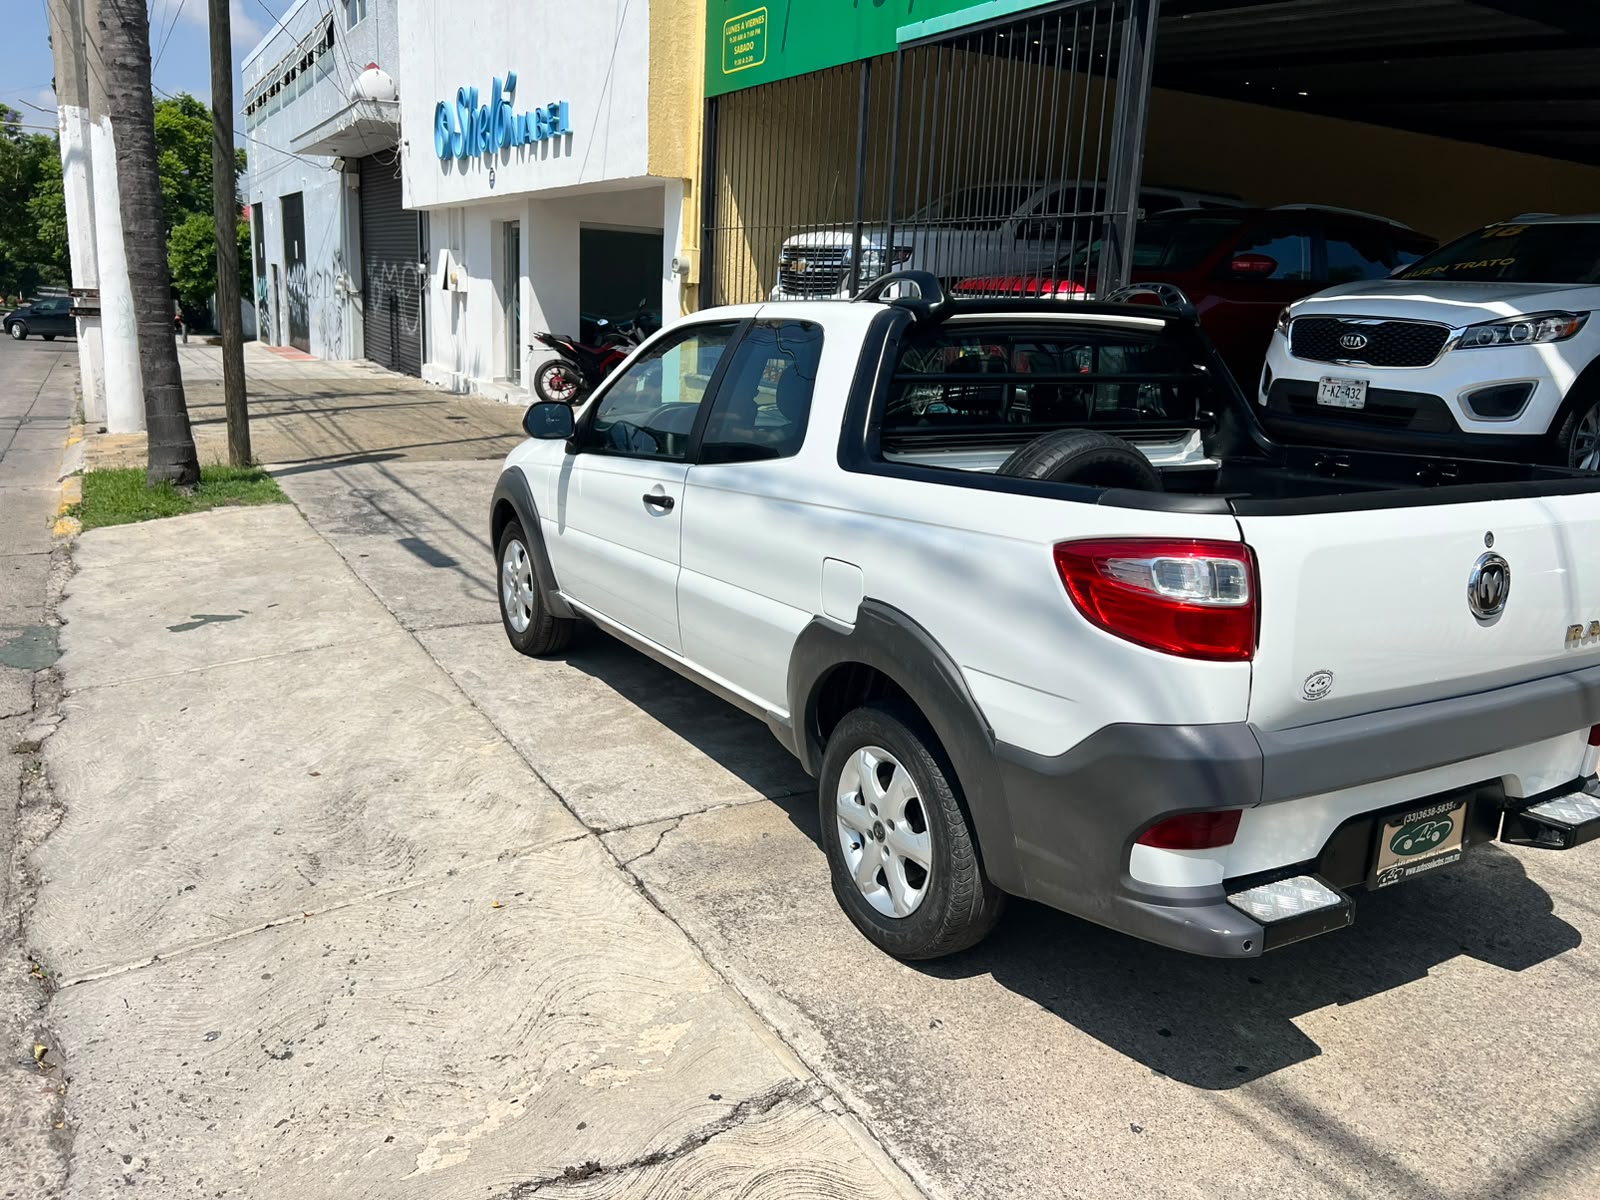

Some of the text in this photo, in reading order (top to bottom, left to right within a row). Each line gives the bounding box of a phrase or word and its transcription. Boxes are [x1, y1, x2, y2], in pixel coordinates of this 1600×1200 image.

[726, 15, 765, 35] LUNES A VIERNES
[511, 100, 570, 147] NABEL
[1454, 257, 1516, 271] TRATO
[1342, 336, 1362, 347] KIA
[1322, 384, 1362, 400] 7-KZ-432
